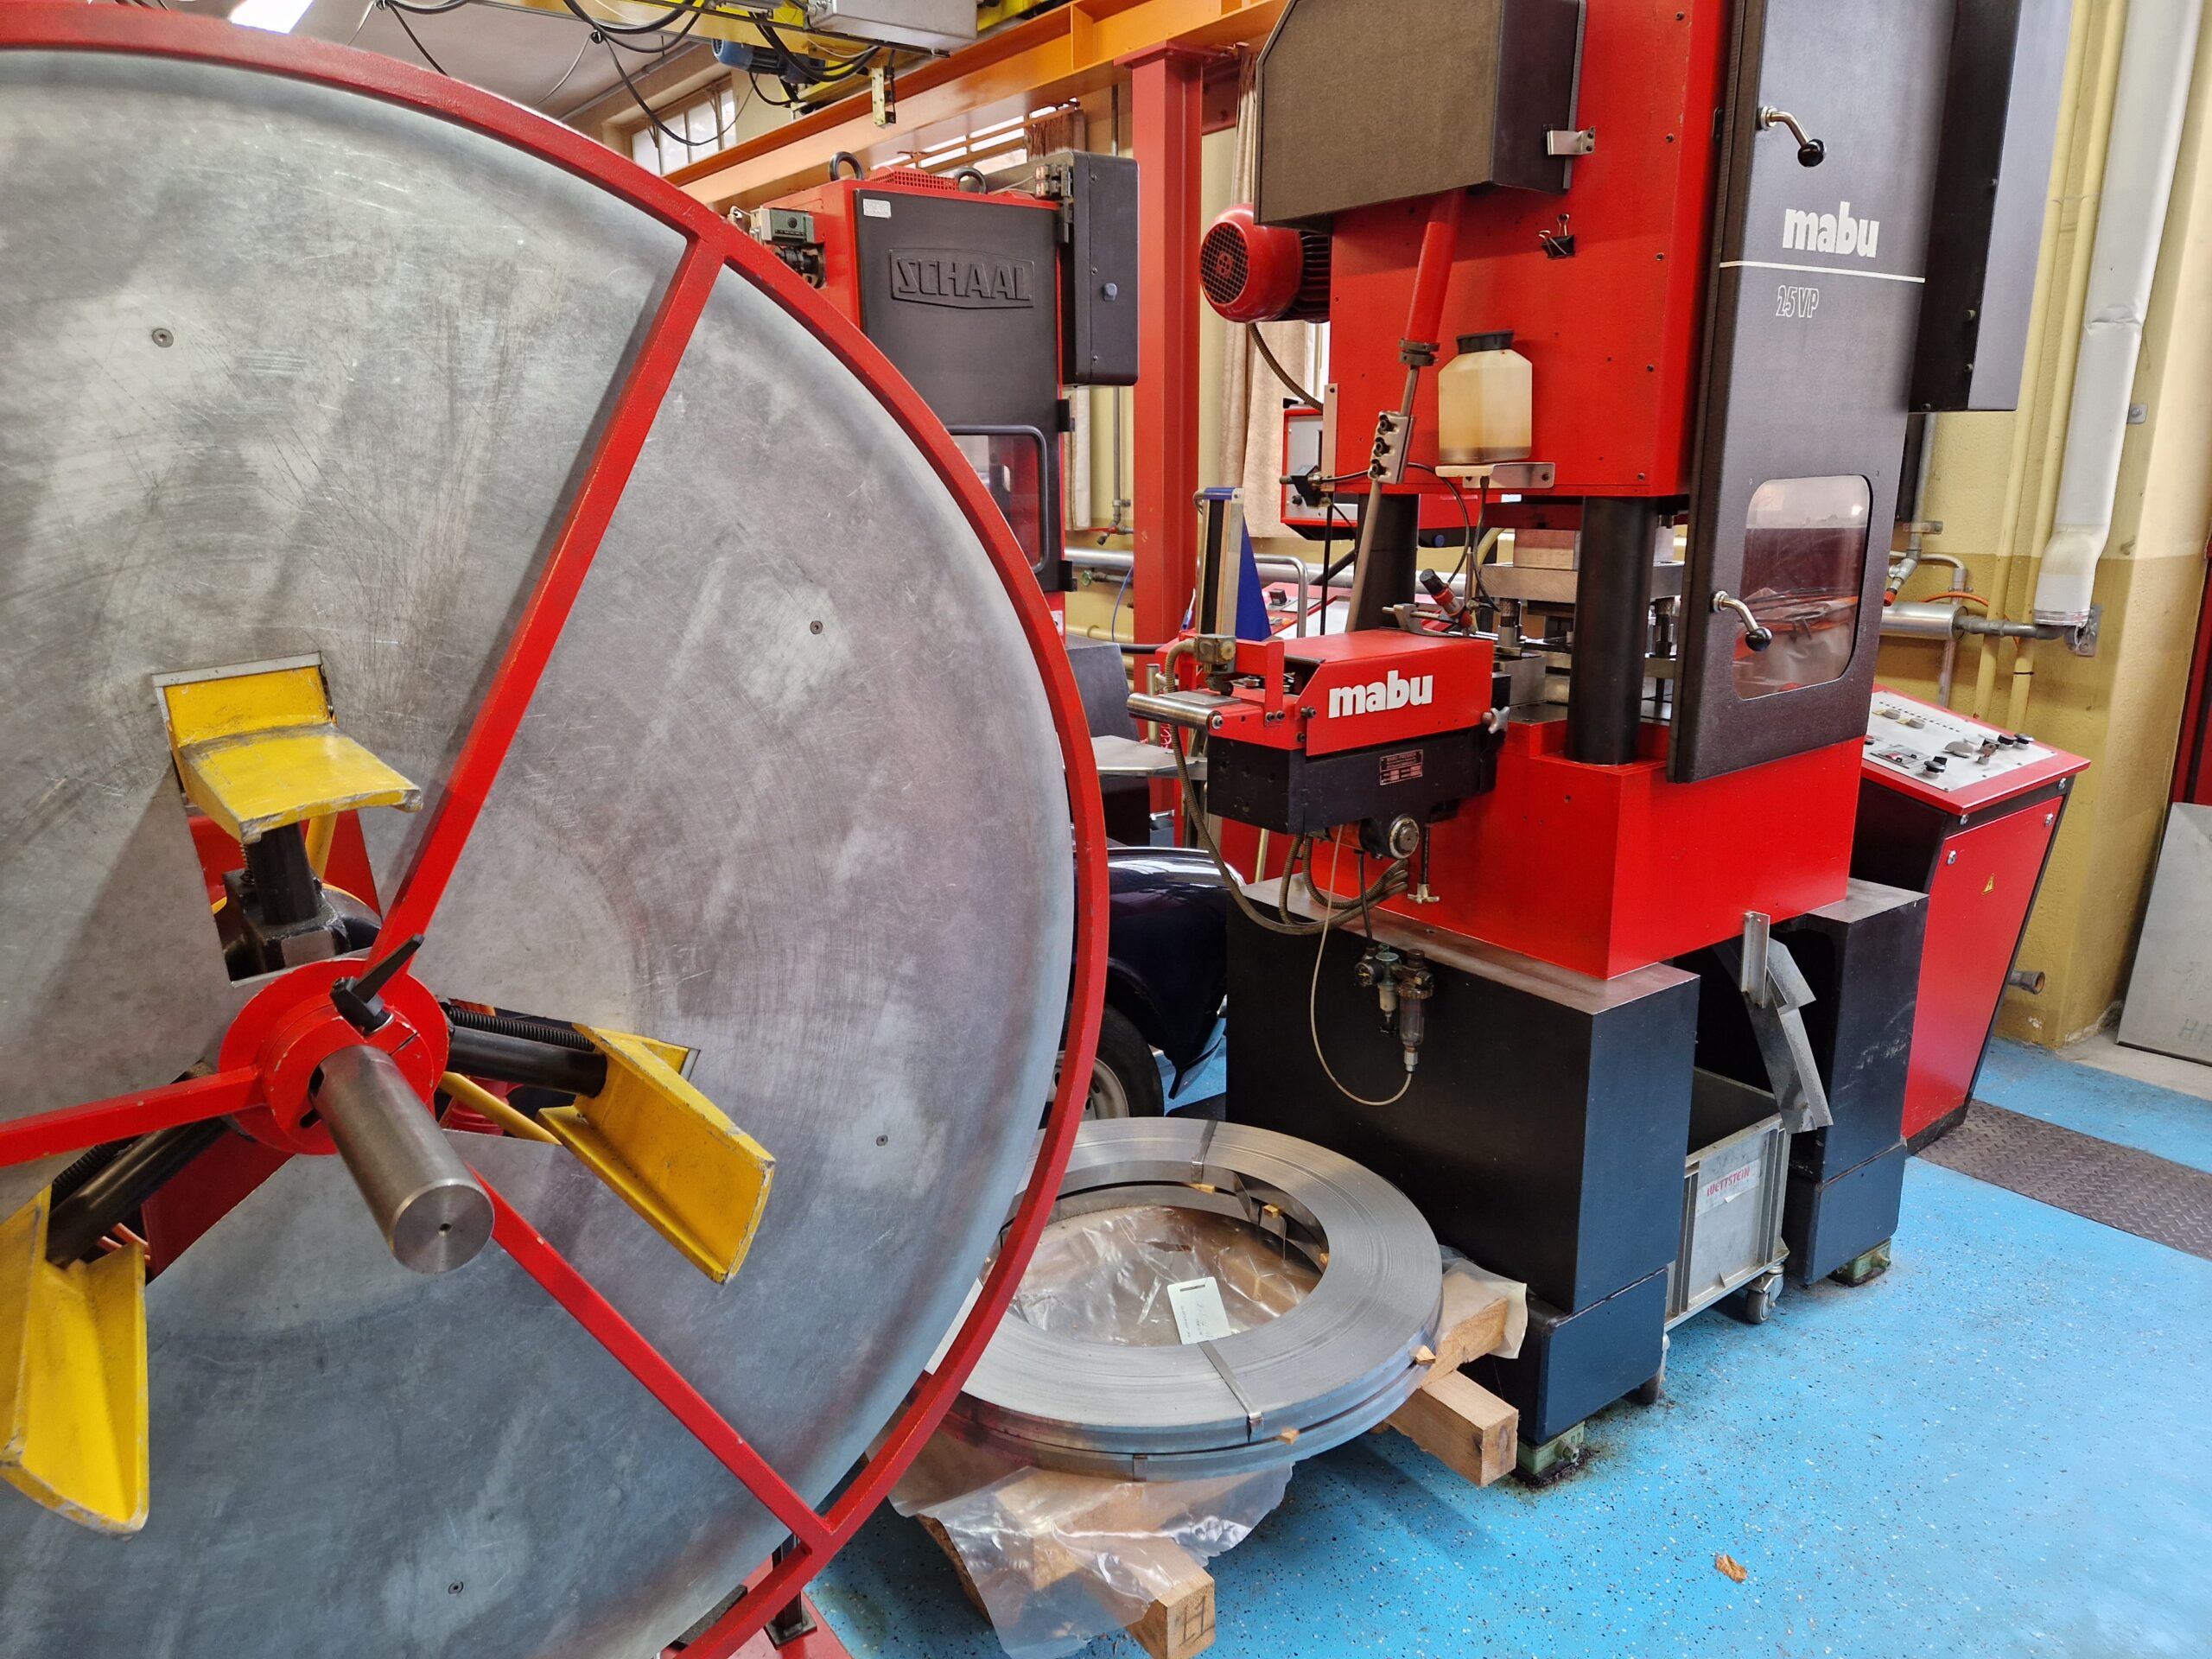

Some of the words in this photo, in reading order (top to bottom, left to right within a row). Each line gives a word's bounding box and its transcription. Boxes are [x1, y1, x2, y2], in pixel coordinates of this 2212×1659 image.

[1782, 200, 1880, 258] mabu
[896, 258, 1032, 302] SCHAAL
[1328, 670, 1433, 719] mabu
